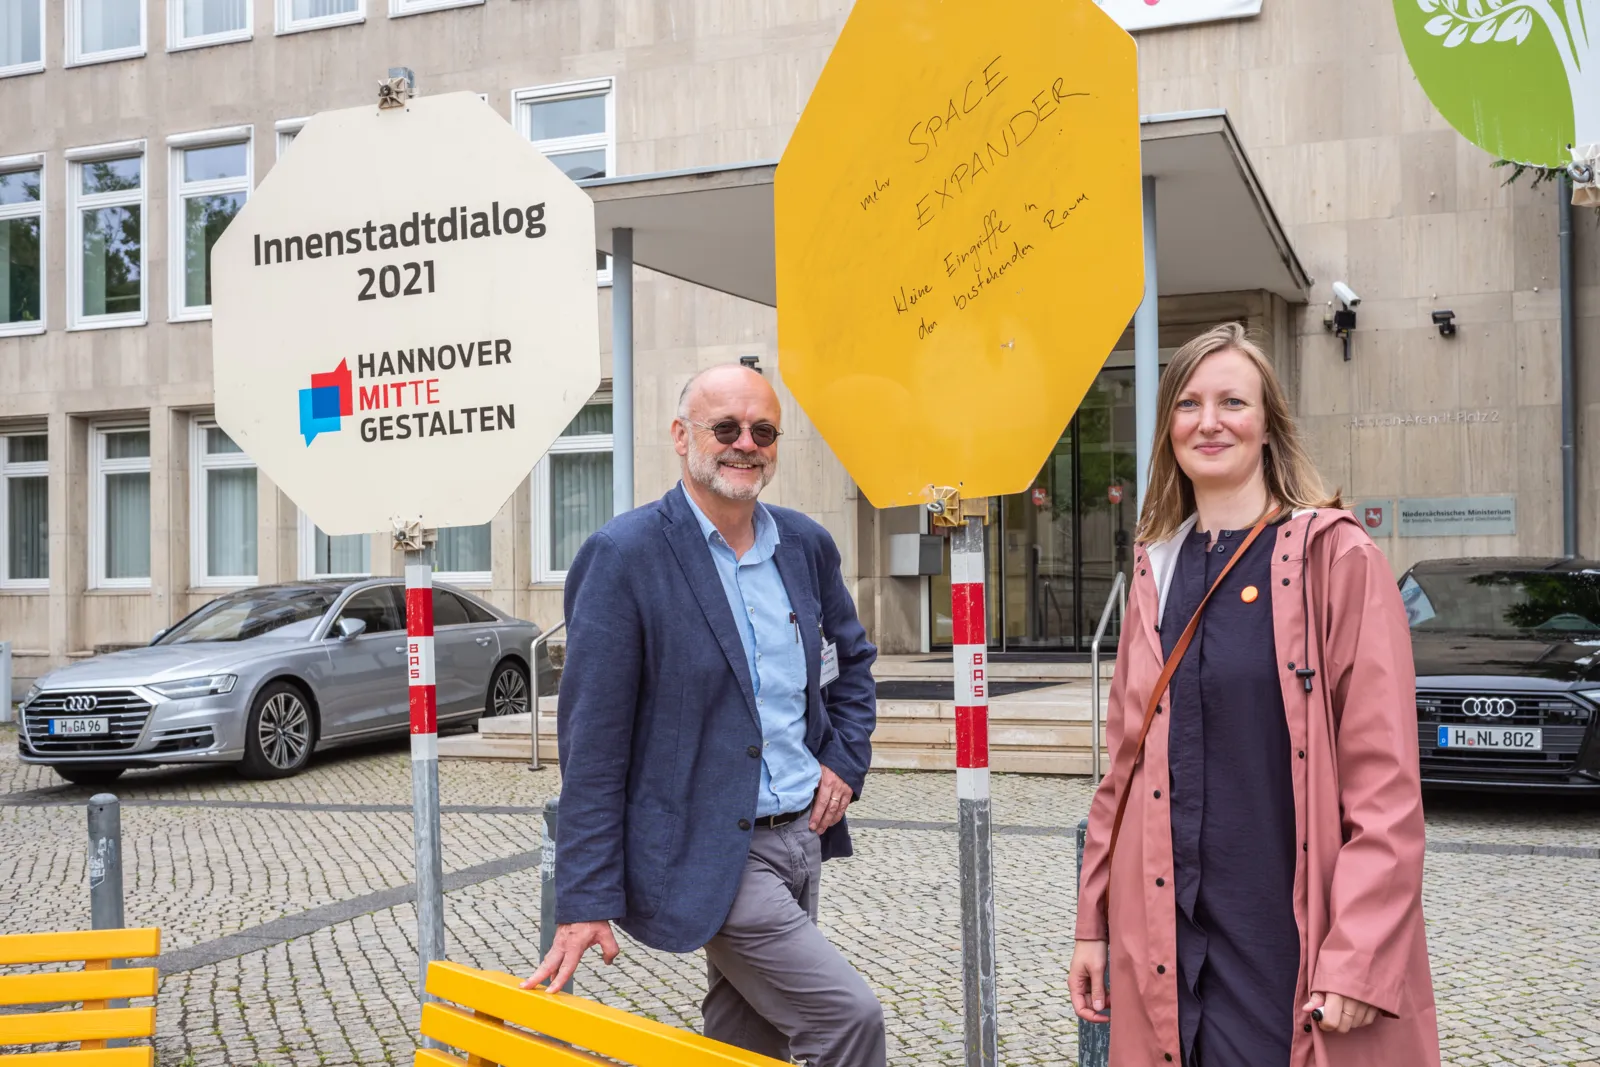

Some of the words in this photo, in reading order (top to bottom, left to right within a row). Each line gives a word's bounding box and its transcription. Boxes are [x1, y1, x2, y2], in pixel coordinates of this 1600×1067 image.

[908, 55, 1009, 163] SPACE
[916, 77, 1091, 231] EXPANDER
[253, 201, 547, 266] Innenstadtdialog
[943, 209, 1011, 278] Eingriffe
[1024, 202, 1039, 213] in
[357, 260, 436, 301] 2021
[917, 317, 938, 340] den
[1043, 193, 1090, 231] Raum
[358, 338, 512, 379] HANNOVER
[359, 378, 440, 411] MITTE
[360, 404, 516, 443] GESTALTEN
[1491, 410, 1500, 423] 2
[1467, 508, 1512, 516] Ministerium
[60, 720, 67, 733] H
[73, 720, 86, 732] GA
[88, 720, 101, 732] 96
[1455, 730, 1466, 745] H
[1477, 730, 1499, 746] NL
[1503, 731, 1535, 748] 802
